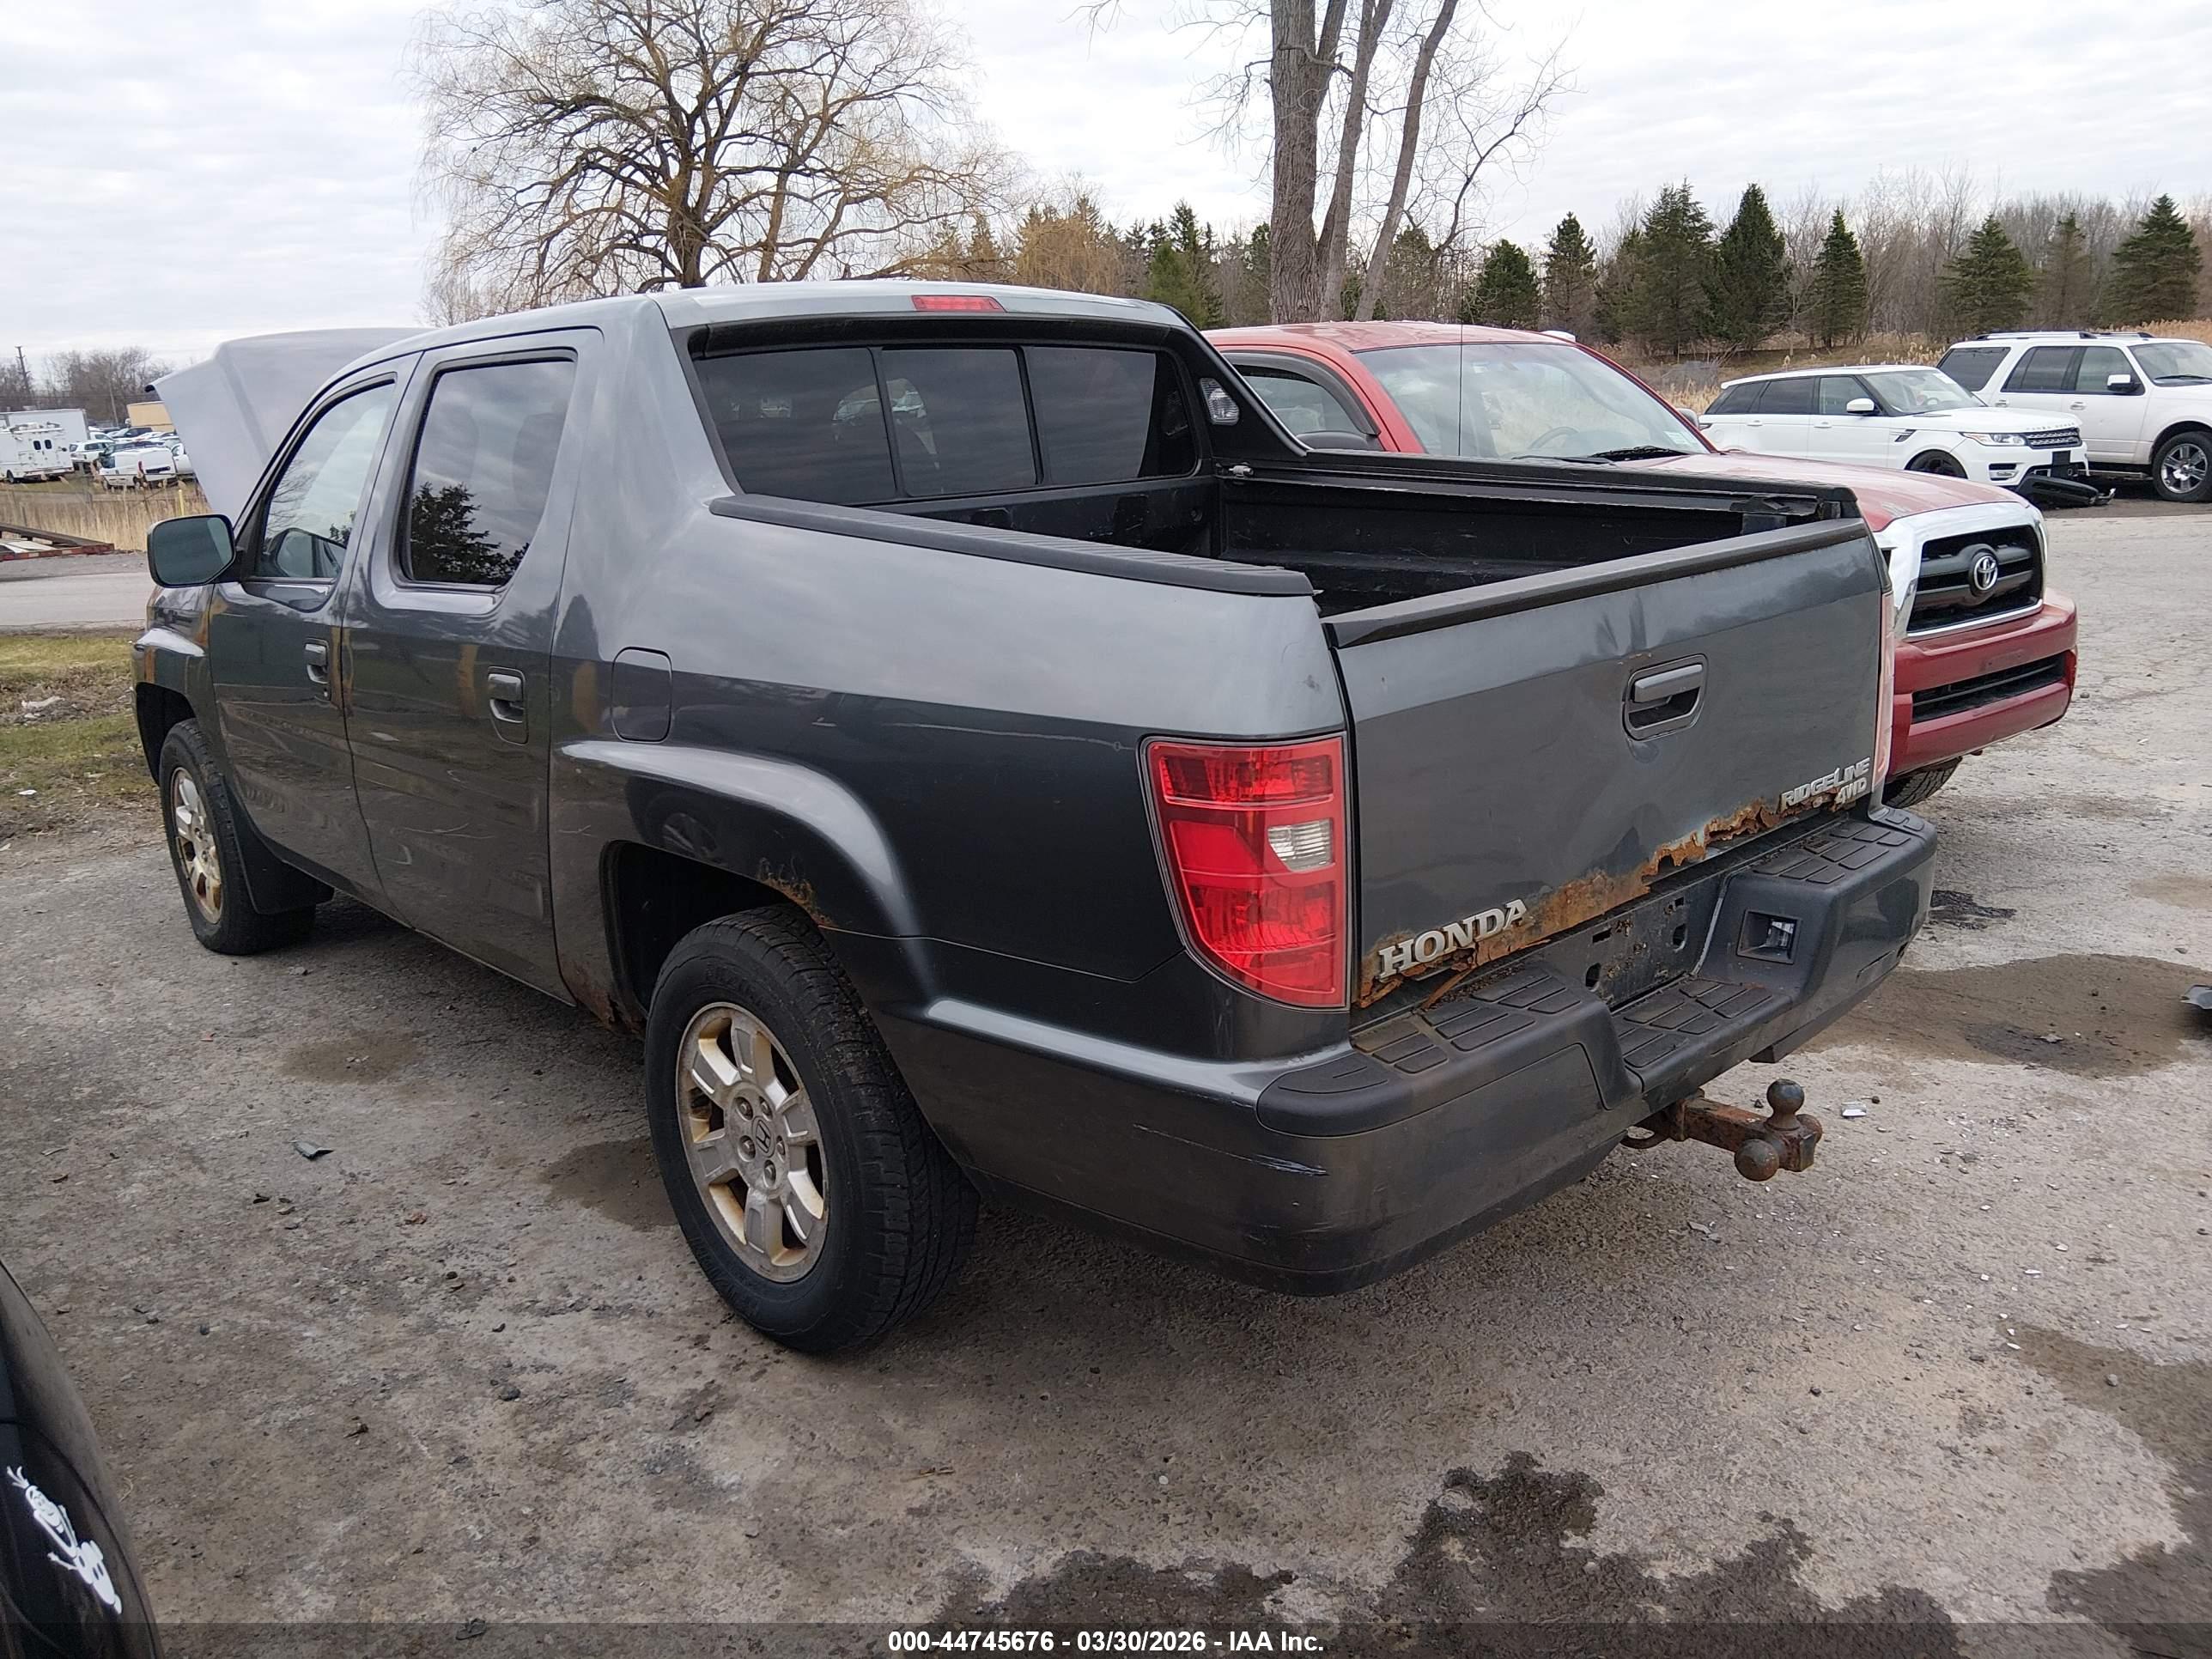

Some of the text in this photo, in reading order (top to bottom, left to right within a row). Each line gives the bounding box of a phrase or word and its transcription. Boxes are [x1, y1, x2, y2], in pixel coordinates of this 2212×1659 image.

[1780, 757, 1870, 811] RIDGELINE
[1834, 777, 1868, 805] 4WD
[1378, 899, 1532, 980] HONDA
